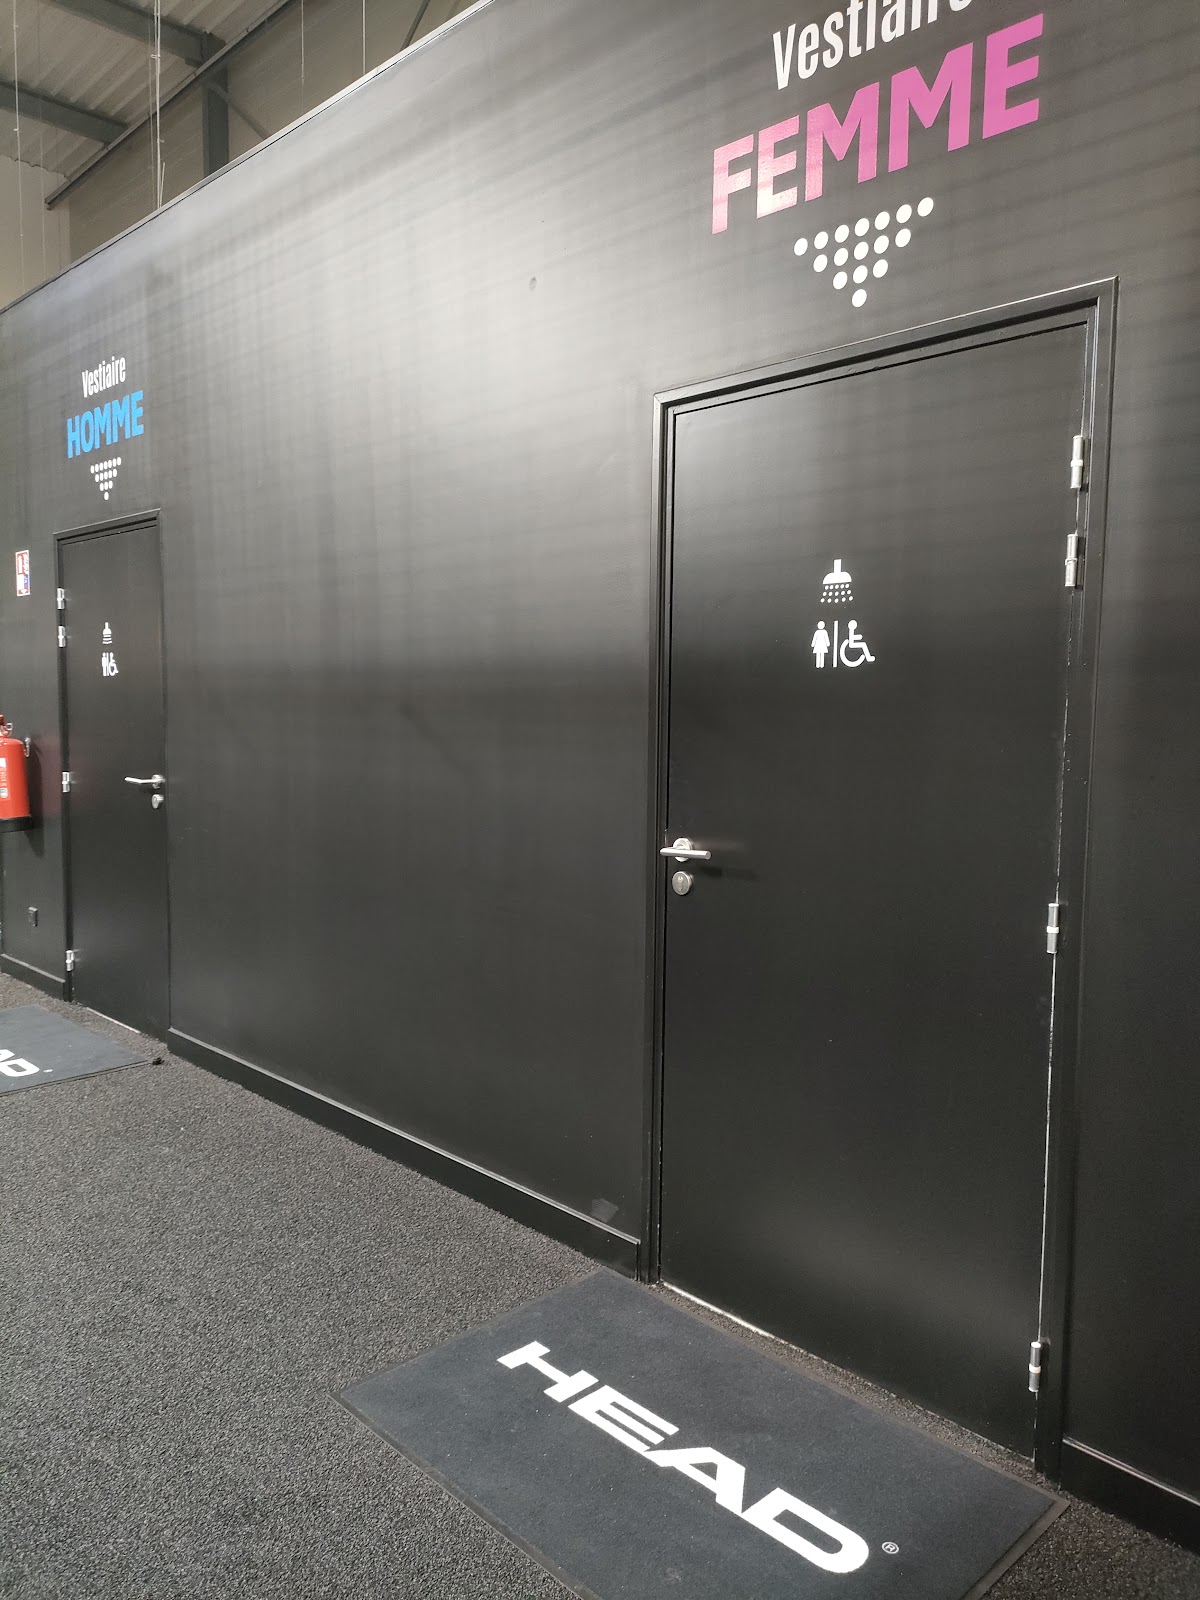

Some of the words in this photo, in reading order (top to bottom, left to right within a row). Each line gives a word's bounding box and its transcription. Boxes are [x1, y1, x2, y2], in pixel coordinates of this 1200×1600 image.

[772, 0, 972, 91] Vestia
[711, 12, 1045, 235] FEMME
[81, 355, 126, 398] Vestiaire
[66, 389, 144, 459] HOMME
[496, 1341, 869, 1574] HEAD
